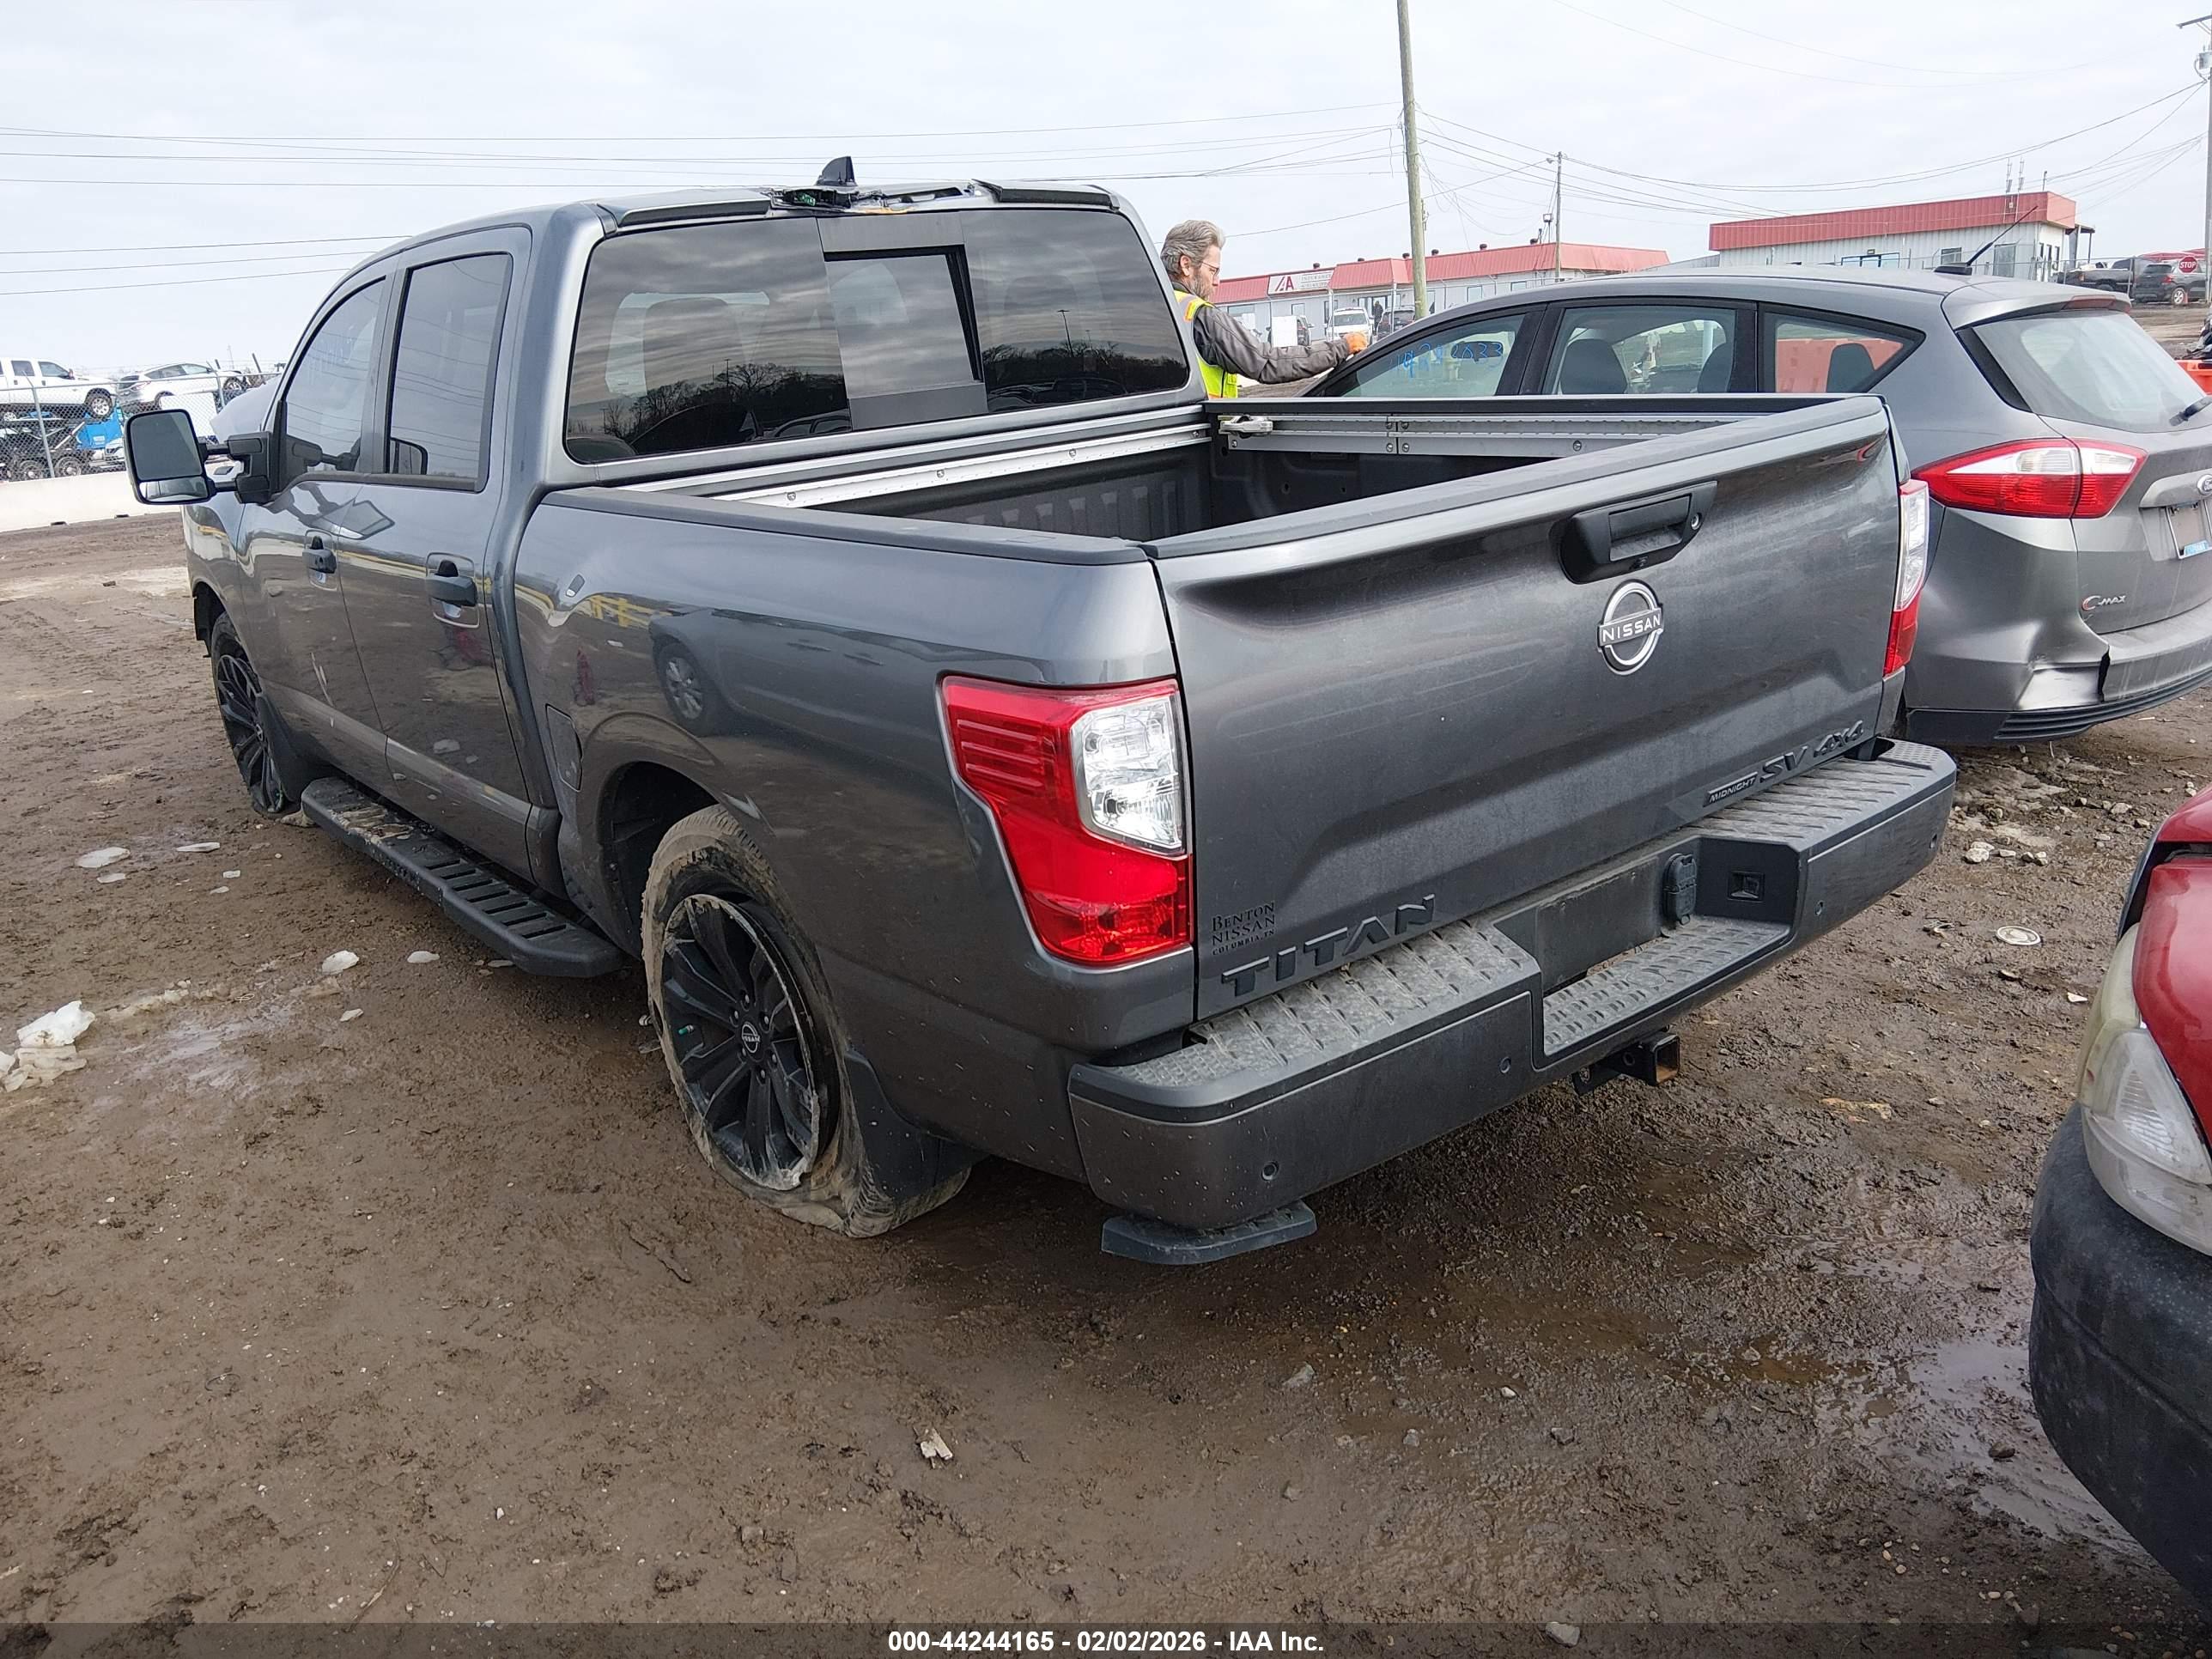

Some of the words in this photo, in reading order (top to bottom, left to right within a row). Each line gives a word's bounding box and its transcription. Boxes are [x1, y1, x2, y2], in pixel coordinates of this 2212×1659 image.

[1602, 613, 1661, 642] NISSAN
[1708, 776, 1756, 804] MIDNIGHT
[1760, 745, 1808, 783] SV
[1212, 915, 1275, 946] NISSAN
[1221, 894, 1435, 997] TITAN
